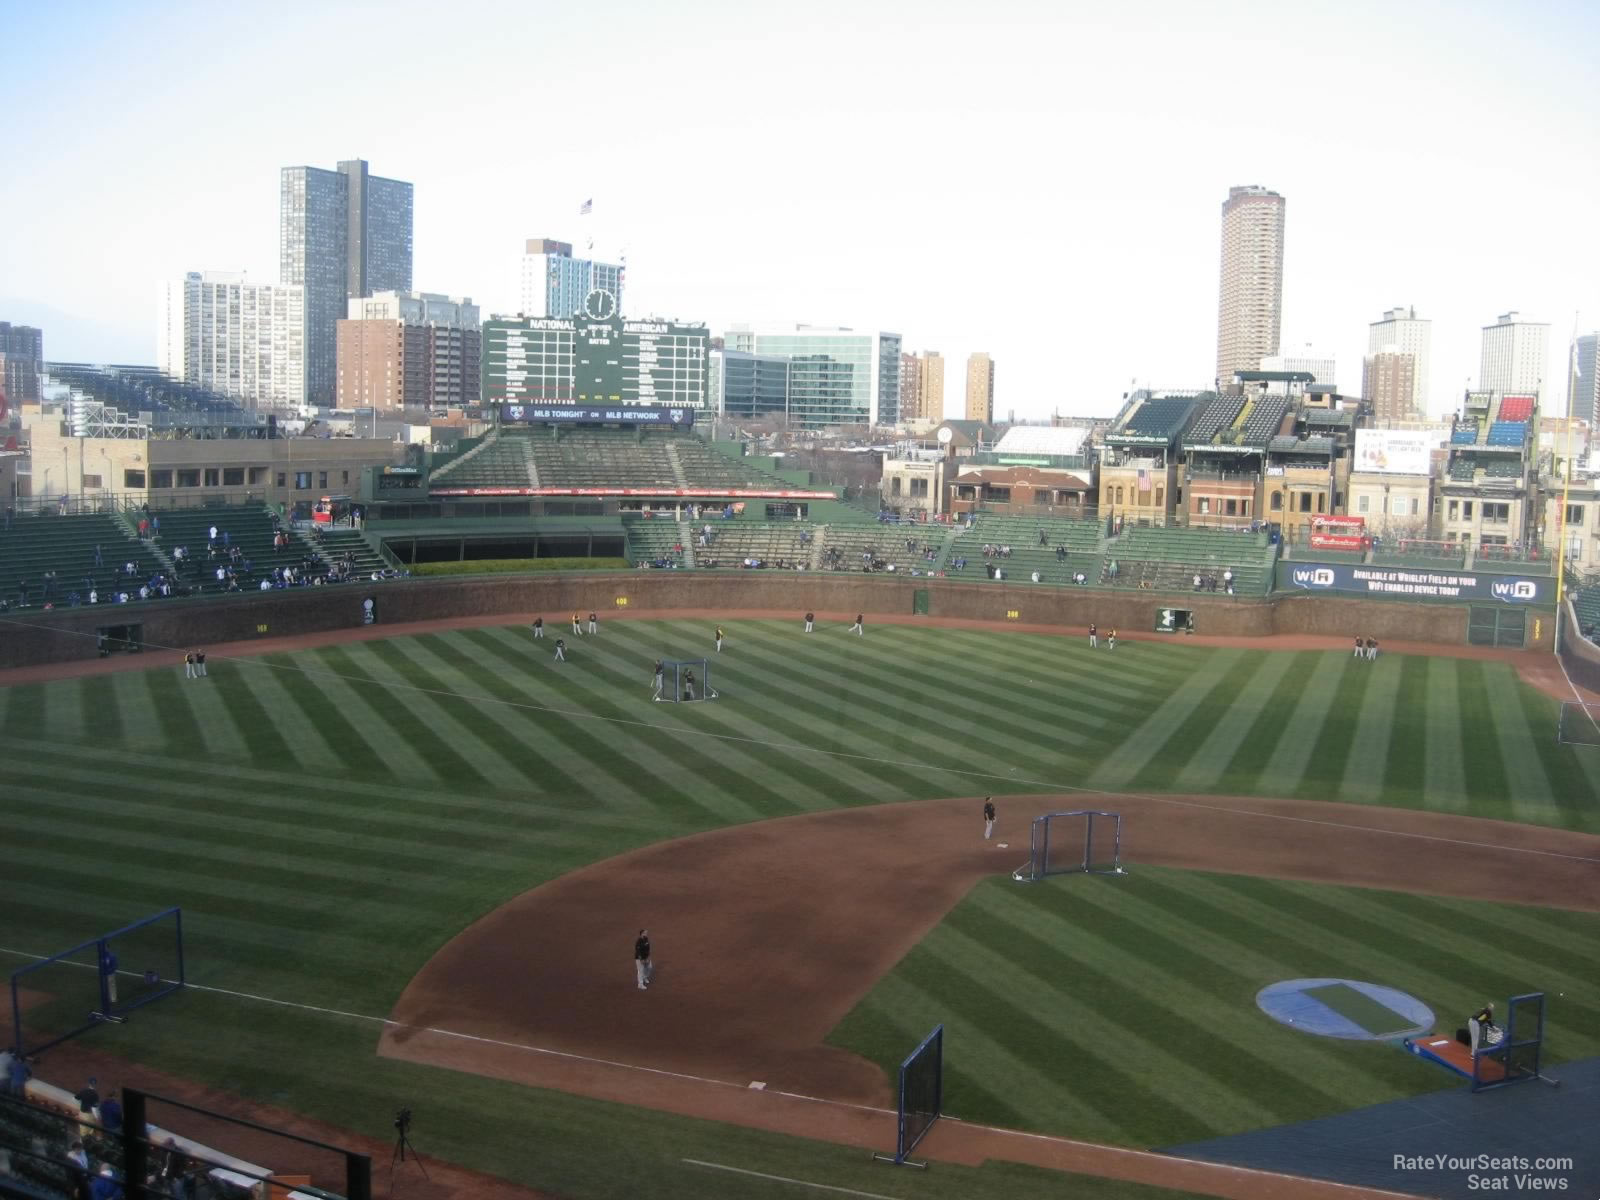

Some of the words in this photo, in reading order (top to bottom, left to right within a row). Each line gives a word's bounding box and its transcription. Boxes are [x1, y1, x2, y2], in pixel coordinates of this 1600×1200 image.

[530, 319, 576, 330] NATIONAL
[623, 323, 668, 333] AMERICAN
[1312, 517, 1360, 526] Budweiser
